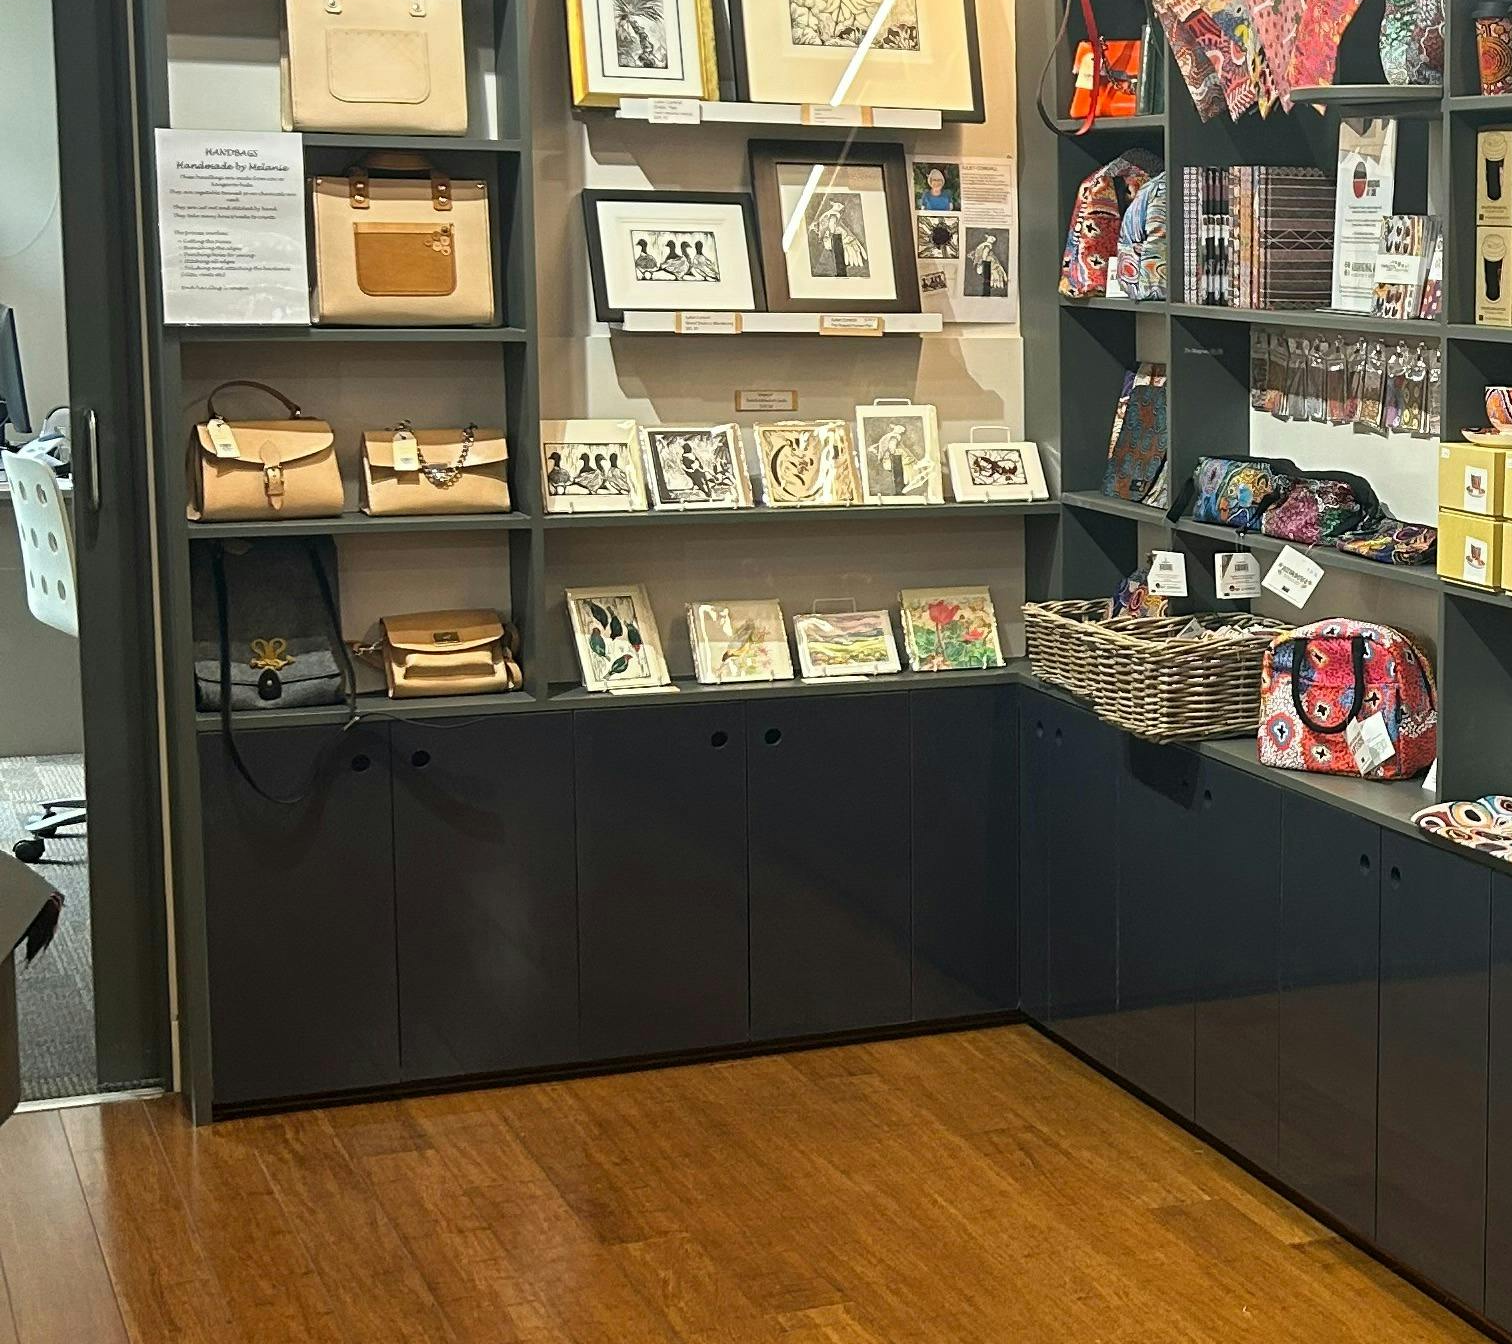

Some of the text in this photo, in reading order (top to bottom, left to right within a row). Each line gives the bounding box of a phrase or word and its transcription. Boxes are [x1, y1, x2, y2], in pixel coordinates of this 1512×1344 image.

[205, 147, 259, 158] HANDBAGS
[176, 161, 290, 173] Handmade by Melanie
